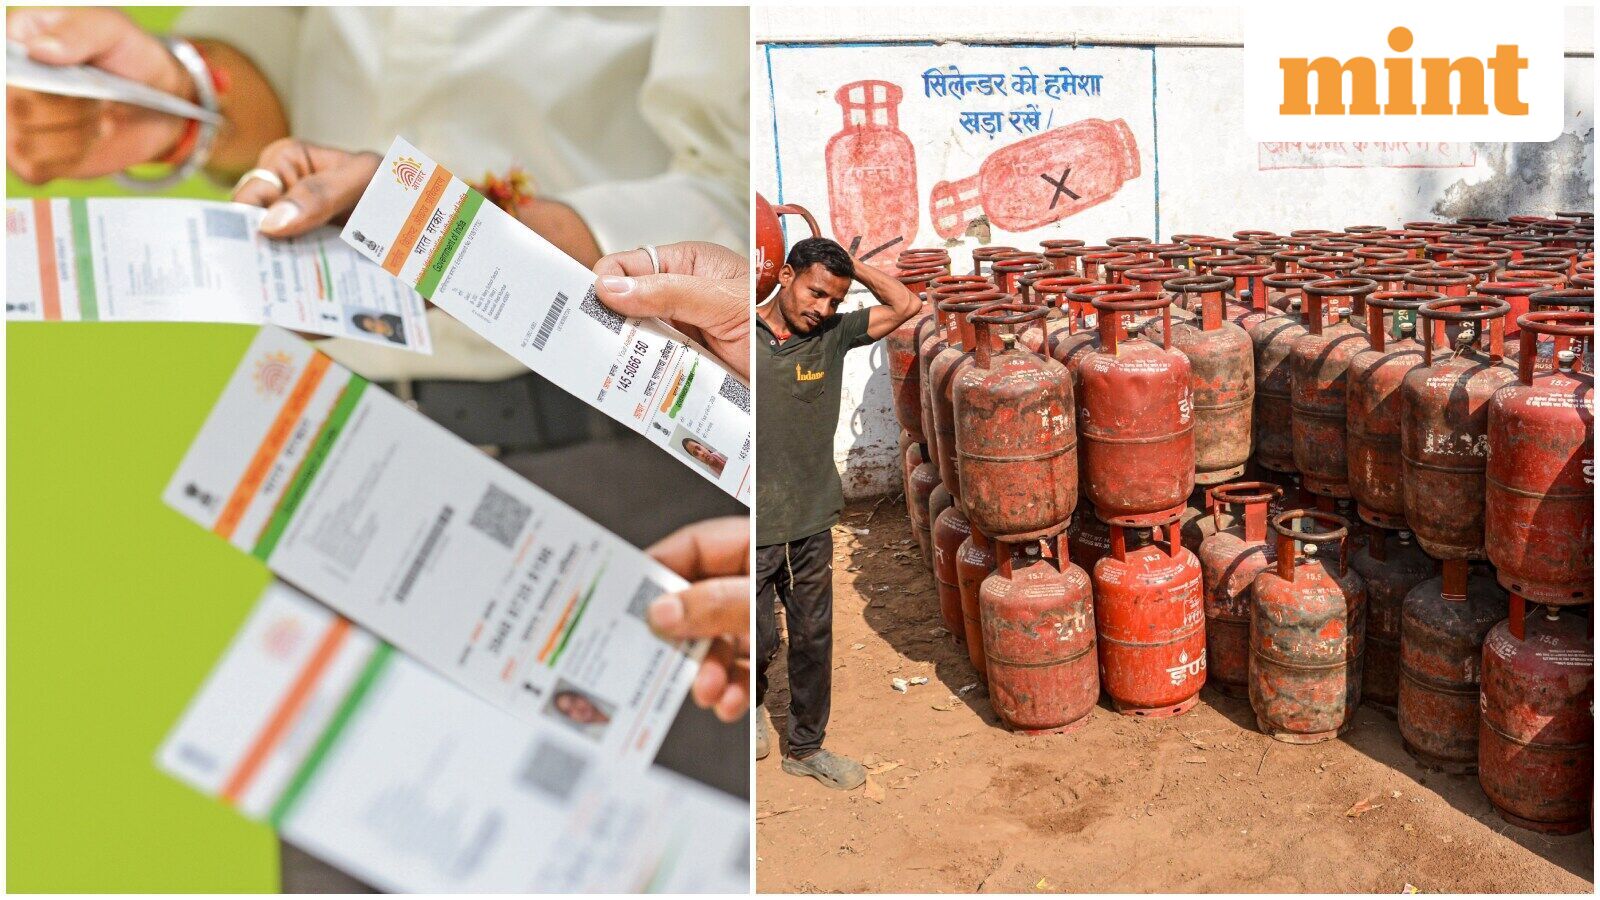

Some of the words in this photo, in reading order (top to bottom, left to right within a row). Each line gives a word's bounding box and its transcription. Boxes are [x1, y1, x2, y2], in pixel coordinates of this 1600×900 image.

[921, 65, 1008, 100] सिलेन्डर
[1011, 66, 1039, 95] को
[1044, 67, 1103, 100] हमेशा
[959, 111, 1004, 140] खड़ा
[413, 234, 432, 256] भारत
[425, 207, 447, 235] सरकार
[452, 218, 466, 235] India
[449, 231, 459, 241] of
[432, 238, 456, 273] Government
[631, 339, 649, 358] 150
[621, 354, 643, 378] 5066
[796, 364, 824, 381] Indane
[615, 375, 633, 393] 145
[1028, 572, 1044, 580] 15.7
[1540, 634, 1560, 646] 15.6
